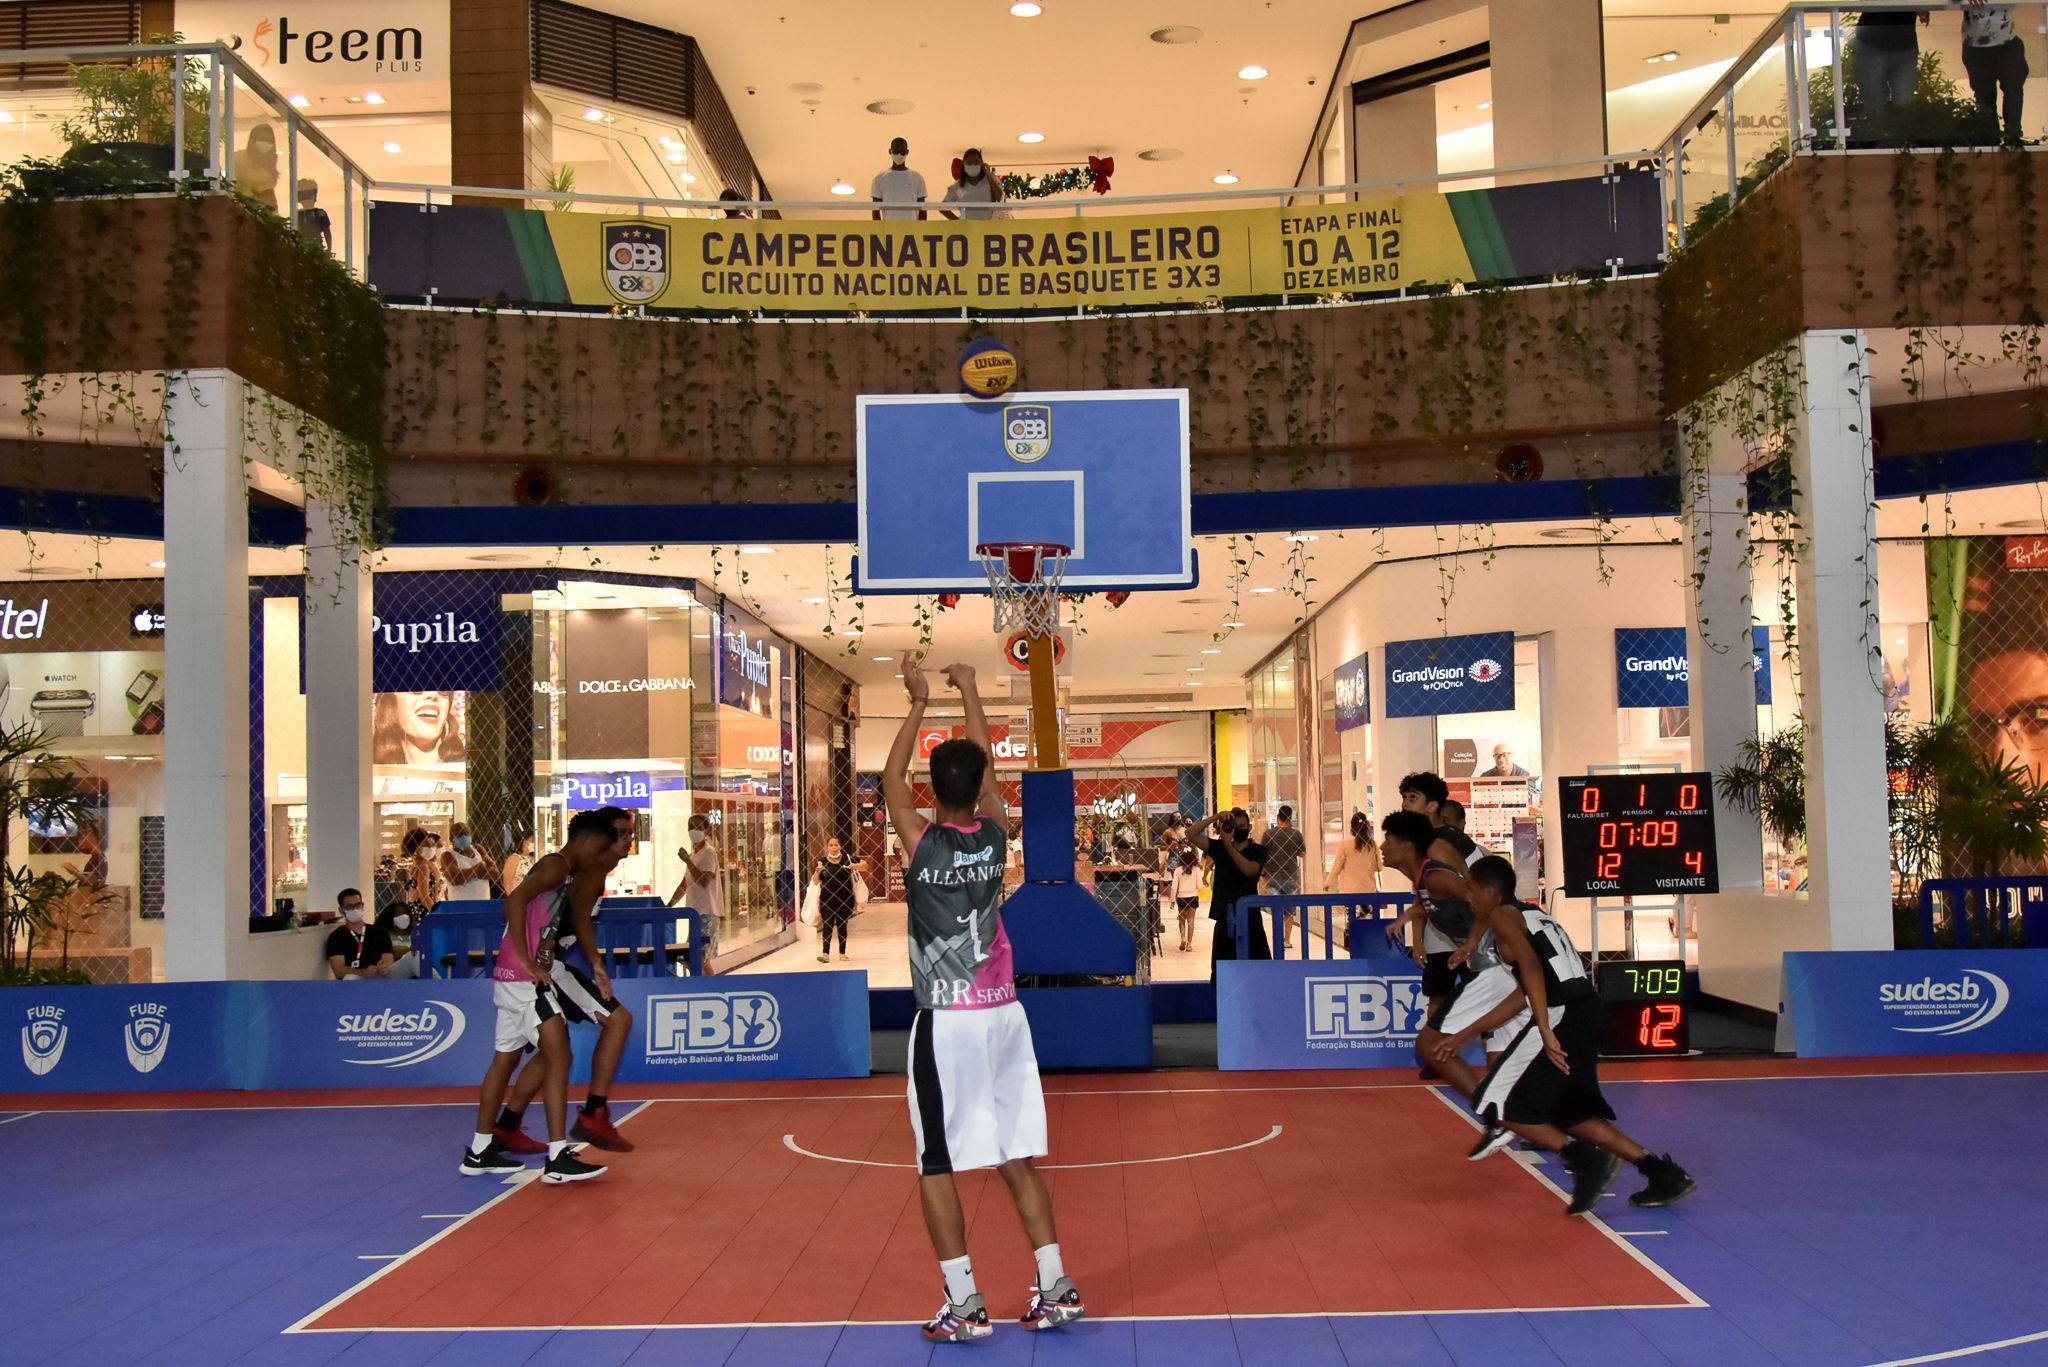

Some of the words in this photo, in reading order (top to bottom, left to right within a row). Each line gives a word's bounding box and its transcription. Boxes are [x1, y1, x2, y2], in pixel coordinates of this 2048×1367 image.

[375, 61, 422, 73] PLUS
[1281, 215, 1341, 235] ETAPA
[1347, 207, 1402, 229] FINAL
[702, 232, 969, 268] CAMPEONATO
[983, 225, 1220, 268] BRASILEIRO
[1283, 238, 1318, 268] 10
[1332, 235, 1354, 264] A
[1366, 230, 1401, 259] 12
[702, 271, 824, 295] CIRCUITO
[834, 272, 967, 297] NACIONAL
[978, 273, 1011, 296] DE
[1020, 267, 1158, 296] BASQUETE
[1167, 264, 1221, 288] 3X3
[1284, 262, 1400, 291] DEZEMBRO
[974, 357, 1013, 369] Wilson
[1392, 667, 1464, 683] GrandVision
[560, 776, 649, 804] Pupila
[1582, 787, 1600, 813] 0
[1639, 784, 1646, 807] 1
[1680, 784, 1697, 810] 0
[1600, 821, 1677, 848] 07:09
[1598, 853, 1621, 879] 12
[1685, 852, 1702, 875] 4
[1587, 881, 1620, 890] LOCAL
[1655, 877, 1706, 888] VISITANTE
[956, 908, 990, 963] 1
[931, 978, 973, 1006] RR
[1625, 968, 1681, 994] 7:09
[1879, 976, 1980, 1002] sudesb
[27, 1005, 65, 1020] FUBE
[129, 1003, 167, 1018] FUBE
[336, 1008, 438, 1033] sudesb
[1640, 1005, 1681, 1048] 12
[1306, 1041, 1349, 1050] Federação
[1351, 1040, 1383, 1048] Bahiana
[1386, 1040, 1396, 1048] de
[646, 1057, 688, 1065] Federação
[690, 1055, 722, 1063] Bahiana
[724, 1054, 734, 1062] de
[736, 1053, 778, 1062] Basketball
